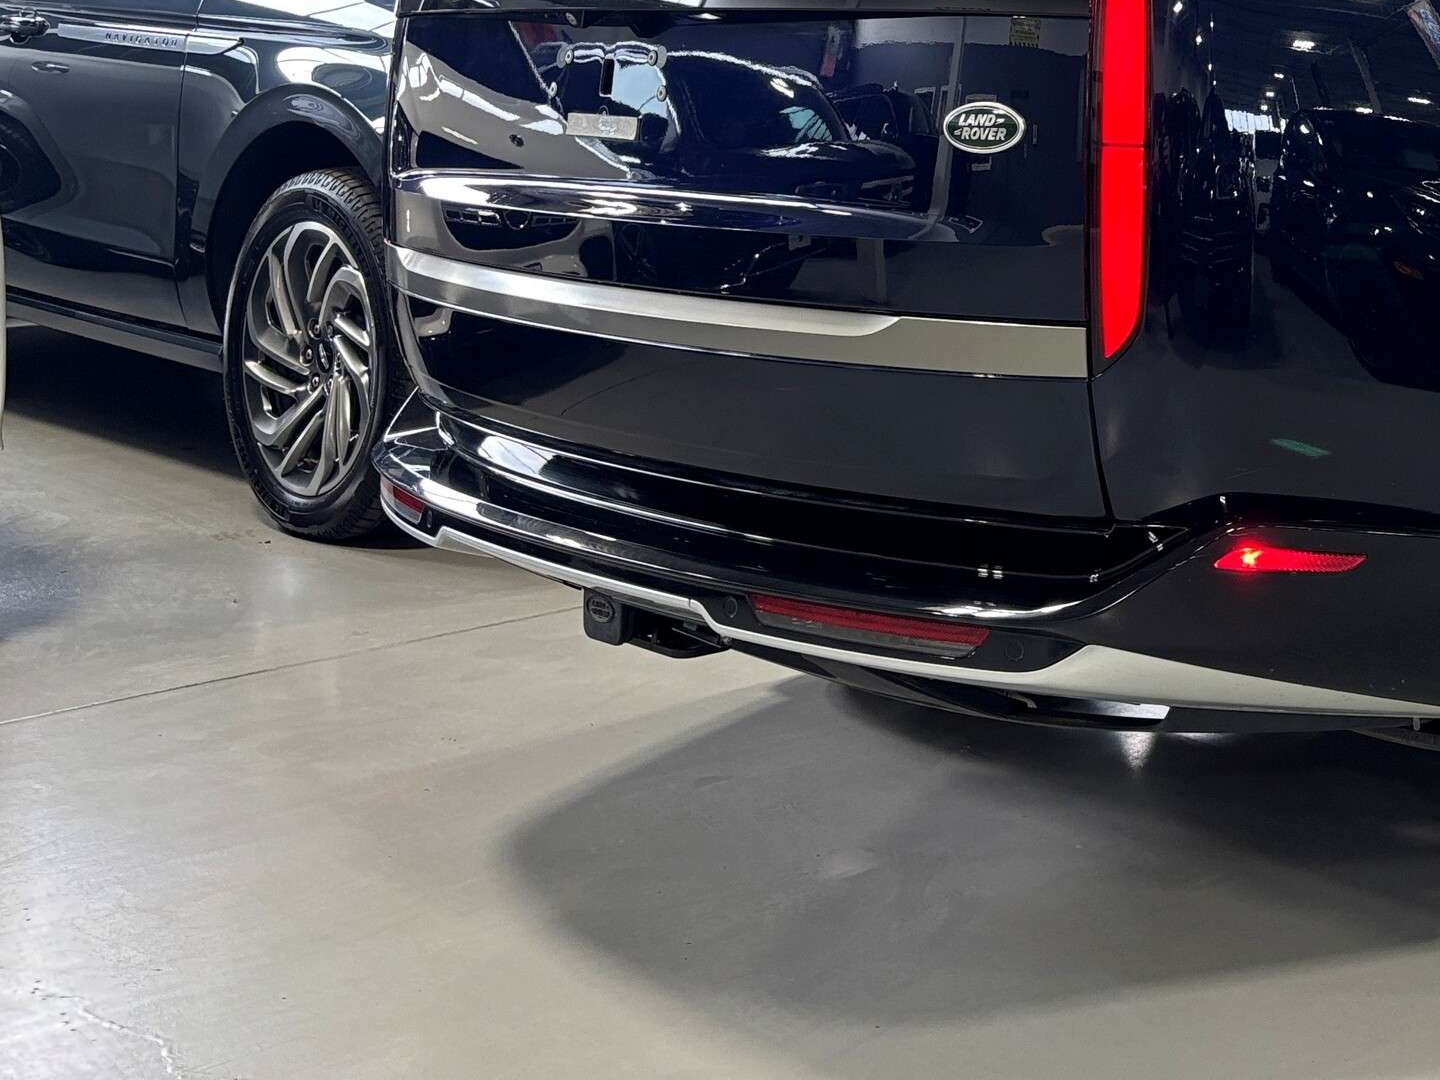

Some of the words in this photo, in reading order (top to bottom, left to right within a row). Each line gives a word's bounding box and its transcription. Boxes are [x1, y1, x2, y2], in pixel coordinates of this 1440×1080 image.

[105, 31, 178, 49] NAVIGATOR
[958, 113, 996, 127] LAND
[960, 127, 1007, 141] ROVER
